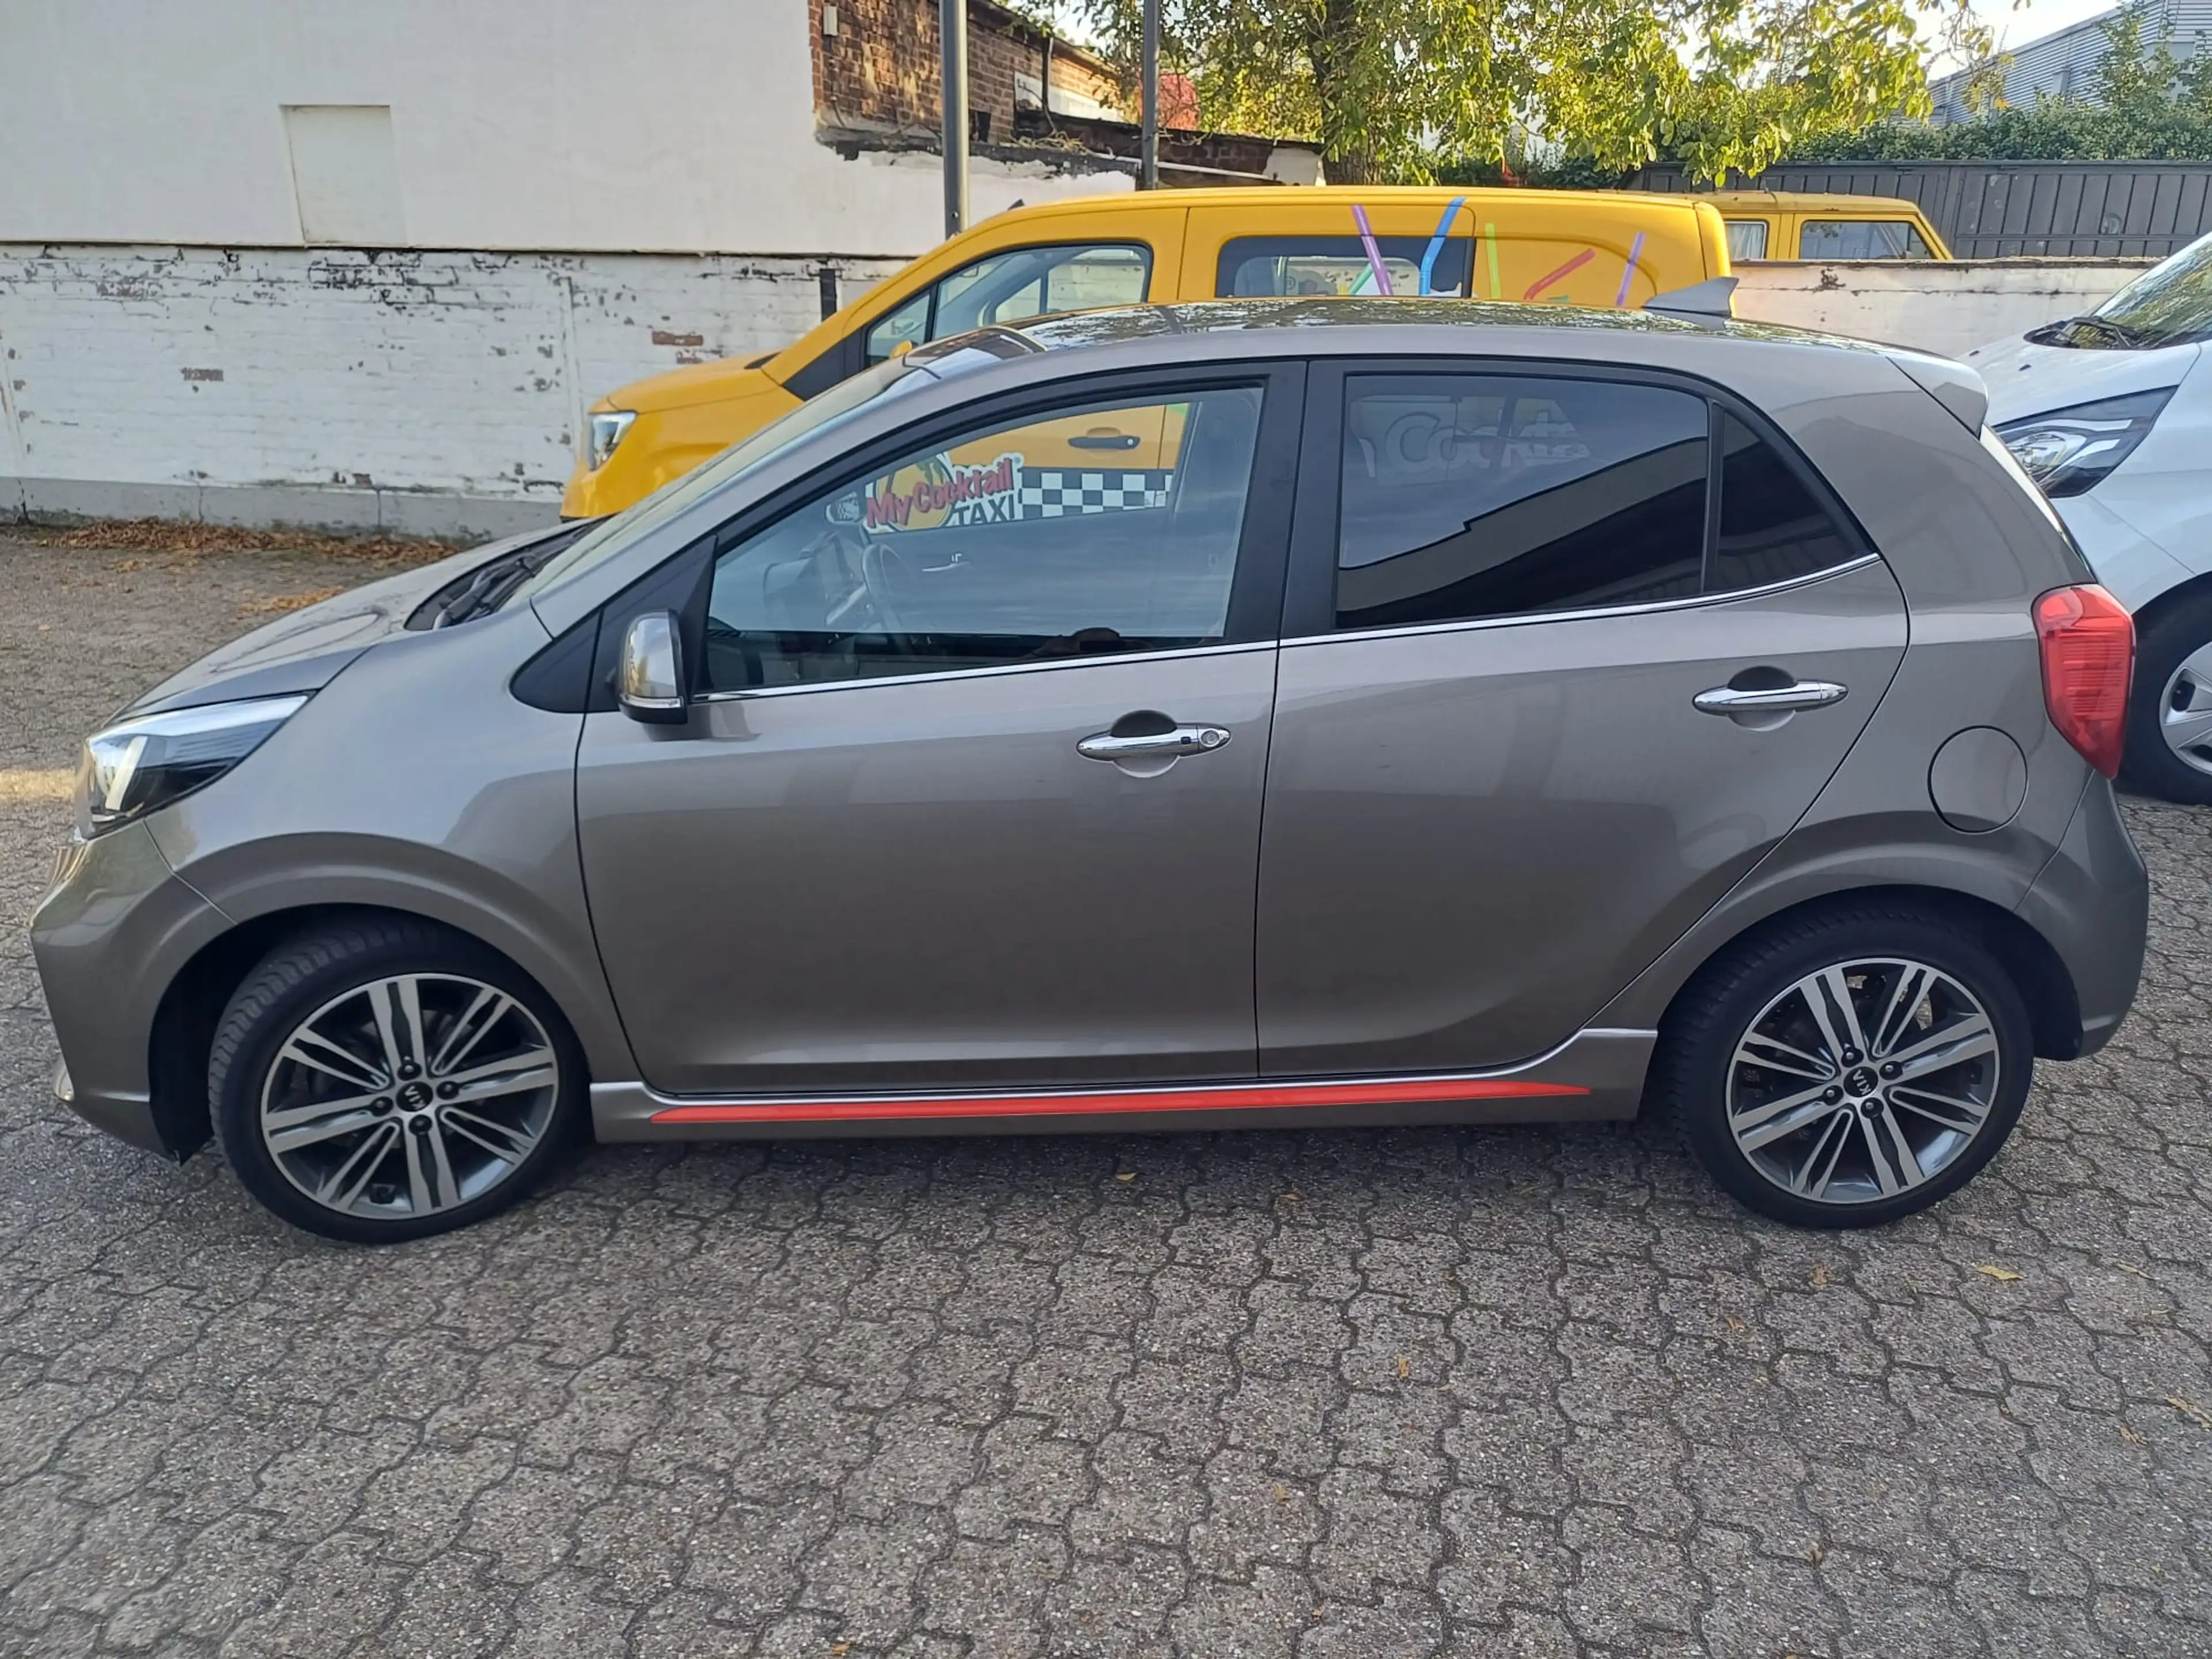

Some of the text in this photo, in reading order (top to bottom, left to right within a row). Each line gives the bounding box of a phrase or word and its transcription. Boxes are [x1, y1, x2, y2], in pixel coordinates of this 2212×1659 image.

[912, 457, 1014, 513] Cocktail
[952, 494, 1015, 525] TAXI
[1853, 1069, 1872, 1095] KIA
[405, 1085, 426, 1109] KIA
